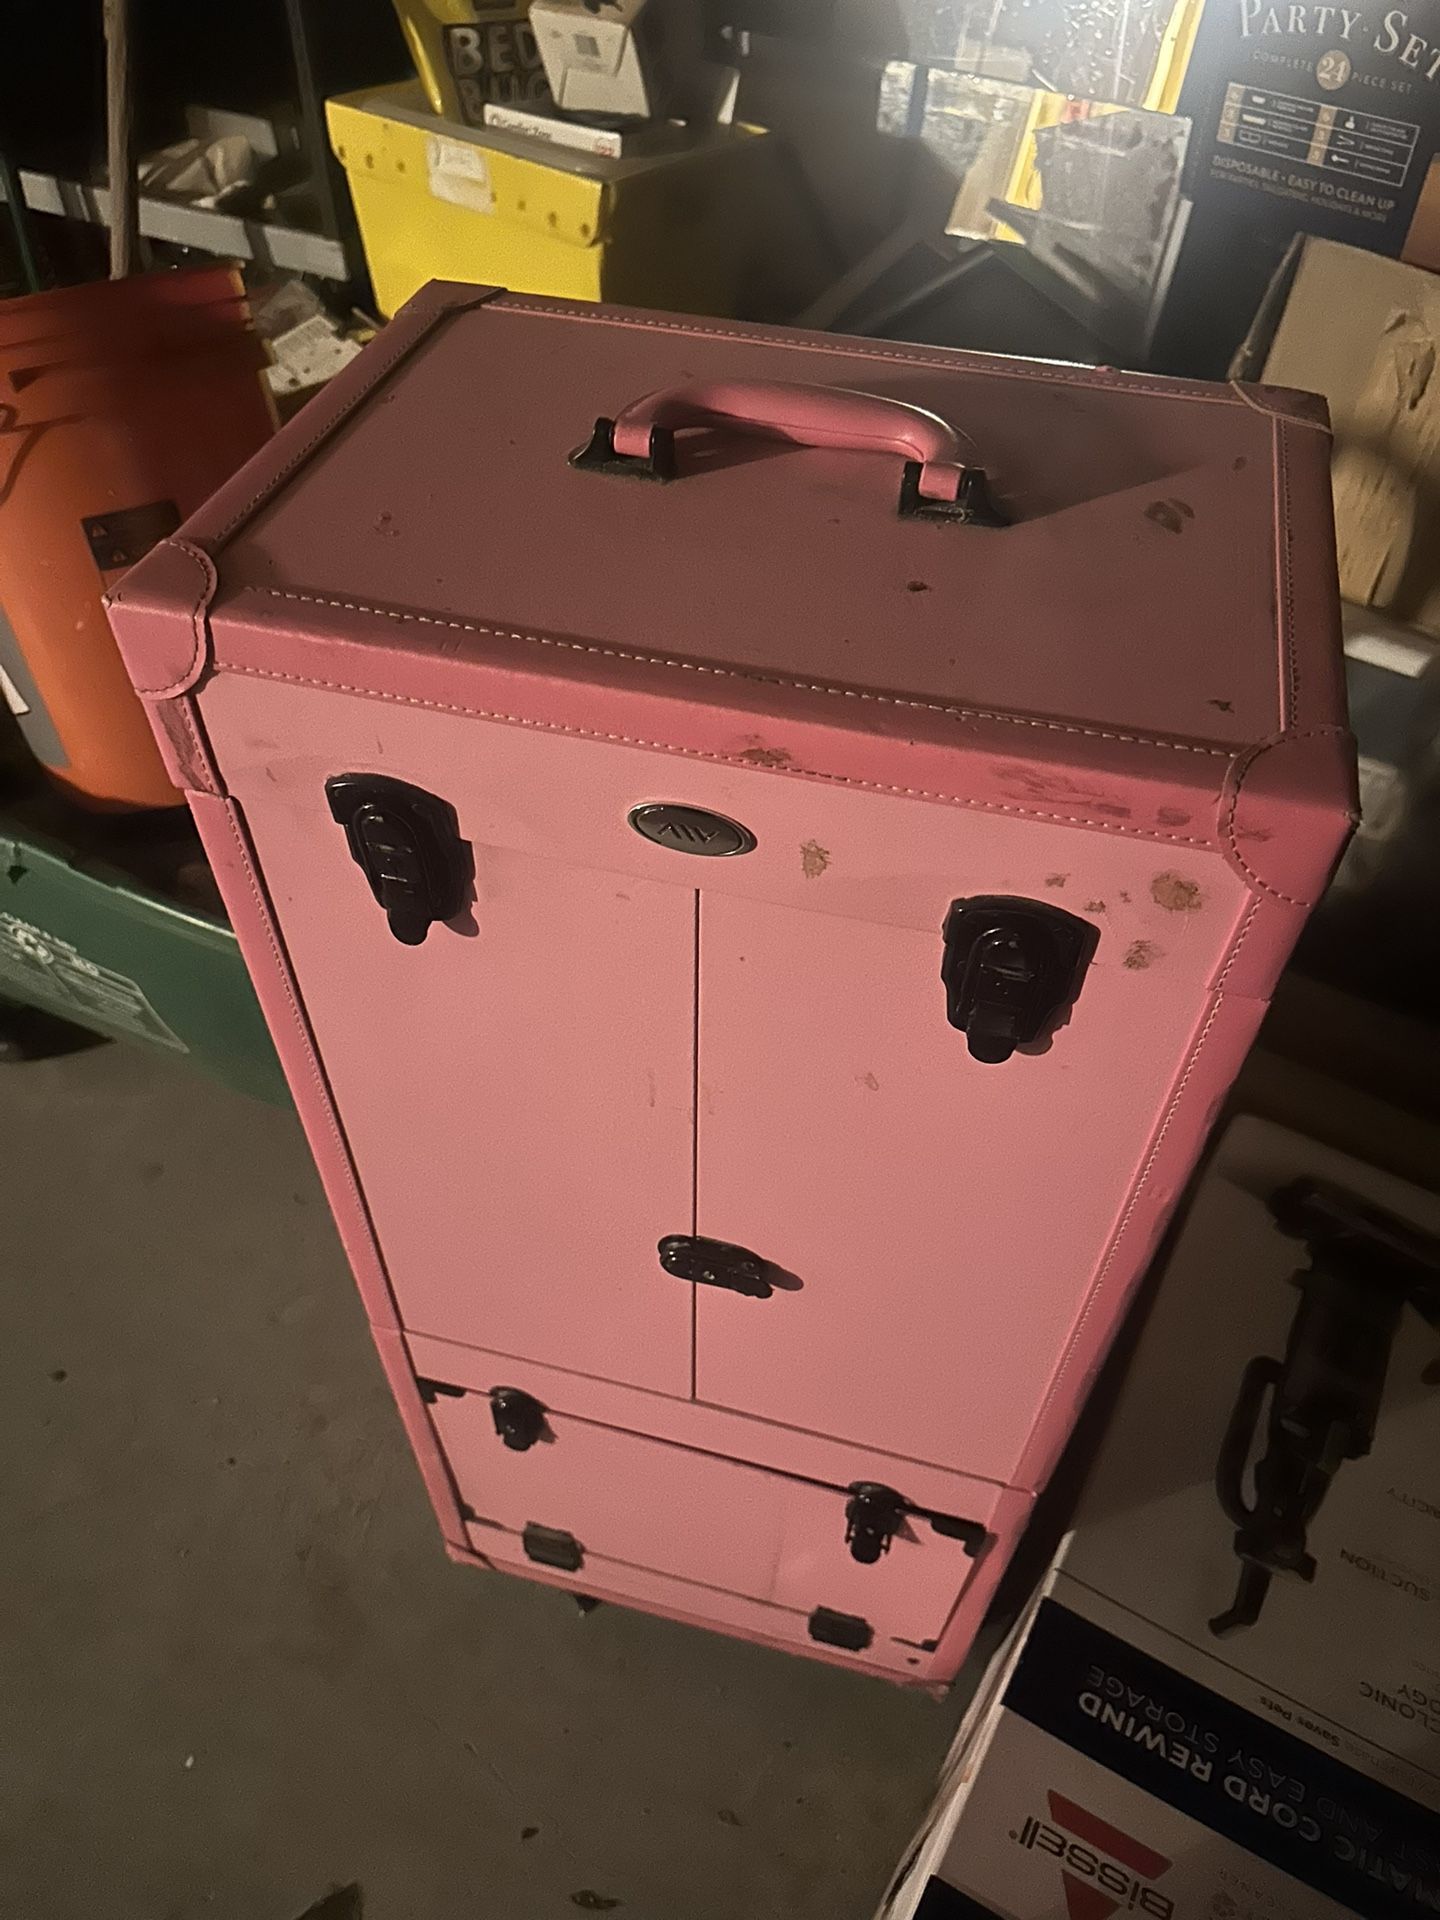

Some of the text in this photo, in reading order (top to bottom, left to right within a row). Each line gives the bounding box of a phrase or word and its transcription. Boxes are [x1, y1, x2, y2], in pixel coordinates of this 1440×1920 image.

[1240, 0, 1362, 39] PARTY
[1317, 56, 1345, 82] 24
[1391, 79, 1413, 95] SET
[1287, 174, 1319, 193] EASY
[1318, 179, 1335, 194] TO
[1336, 186, 1376, 207] CLEAN
[1340, 1548, 1431, 1601] SUCTION
[1090, 1665, 1221, 1753] STORAGE
[1260, 1696, 1293, 1721] Pets
[1299, 1715, 1341, 1747] Saves
[1078, 1691, 1214, 1783] REWIND
[1228, 1748, 1307, 1800] EASY
[1223, 1775, 1322, 1842] CORD
[1316, 1796, 1384, 1843] AND
